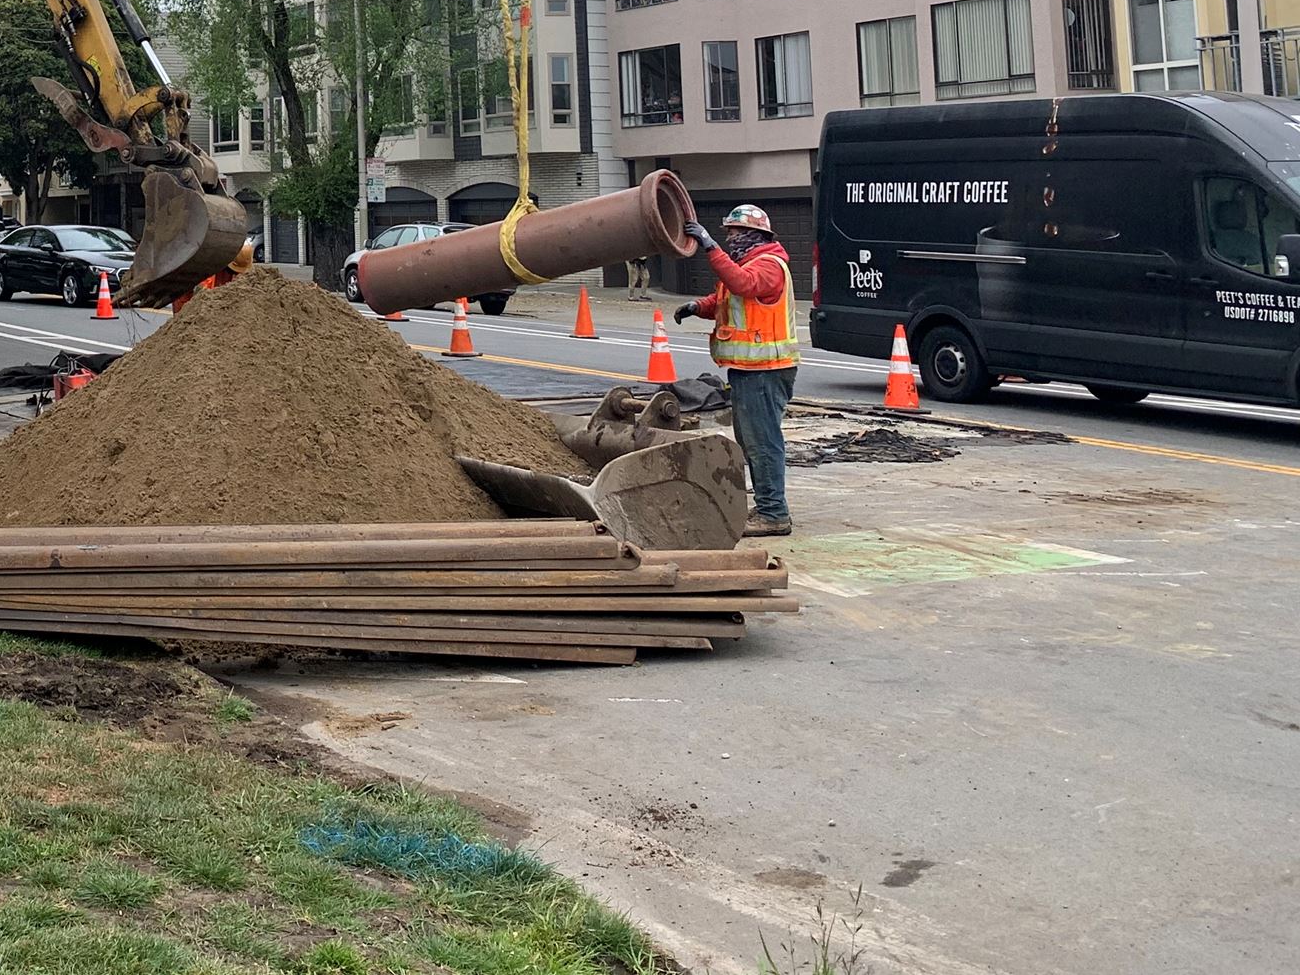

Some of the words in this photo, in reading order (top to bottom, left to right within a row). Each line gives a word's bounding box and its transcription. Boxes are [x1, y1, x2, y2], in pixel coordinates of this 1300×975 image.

[846, 182, 865, 203] THE
[868, 182, 919, 203] ORIGINAL
[922, 181, 960, 203] CRAFT
[963, 181, 1009, 203] COFFEE
[846, 261, 883, 291] Peet's
[856, 291, 877, 299] COFFEE
[1216, 290, 1244, 305] PEET'S
[1245, 293, 1276, 307] COFFEE
[1277, 295, 1284, 308] &
[1224, 306, 1255, 320] USDOT#
[1258, 309, 1295, 324] 2716898
